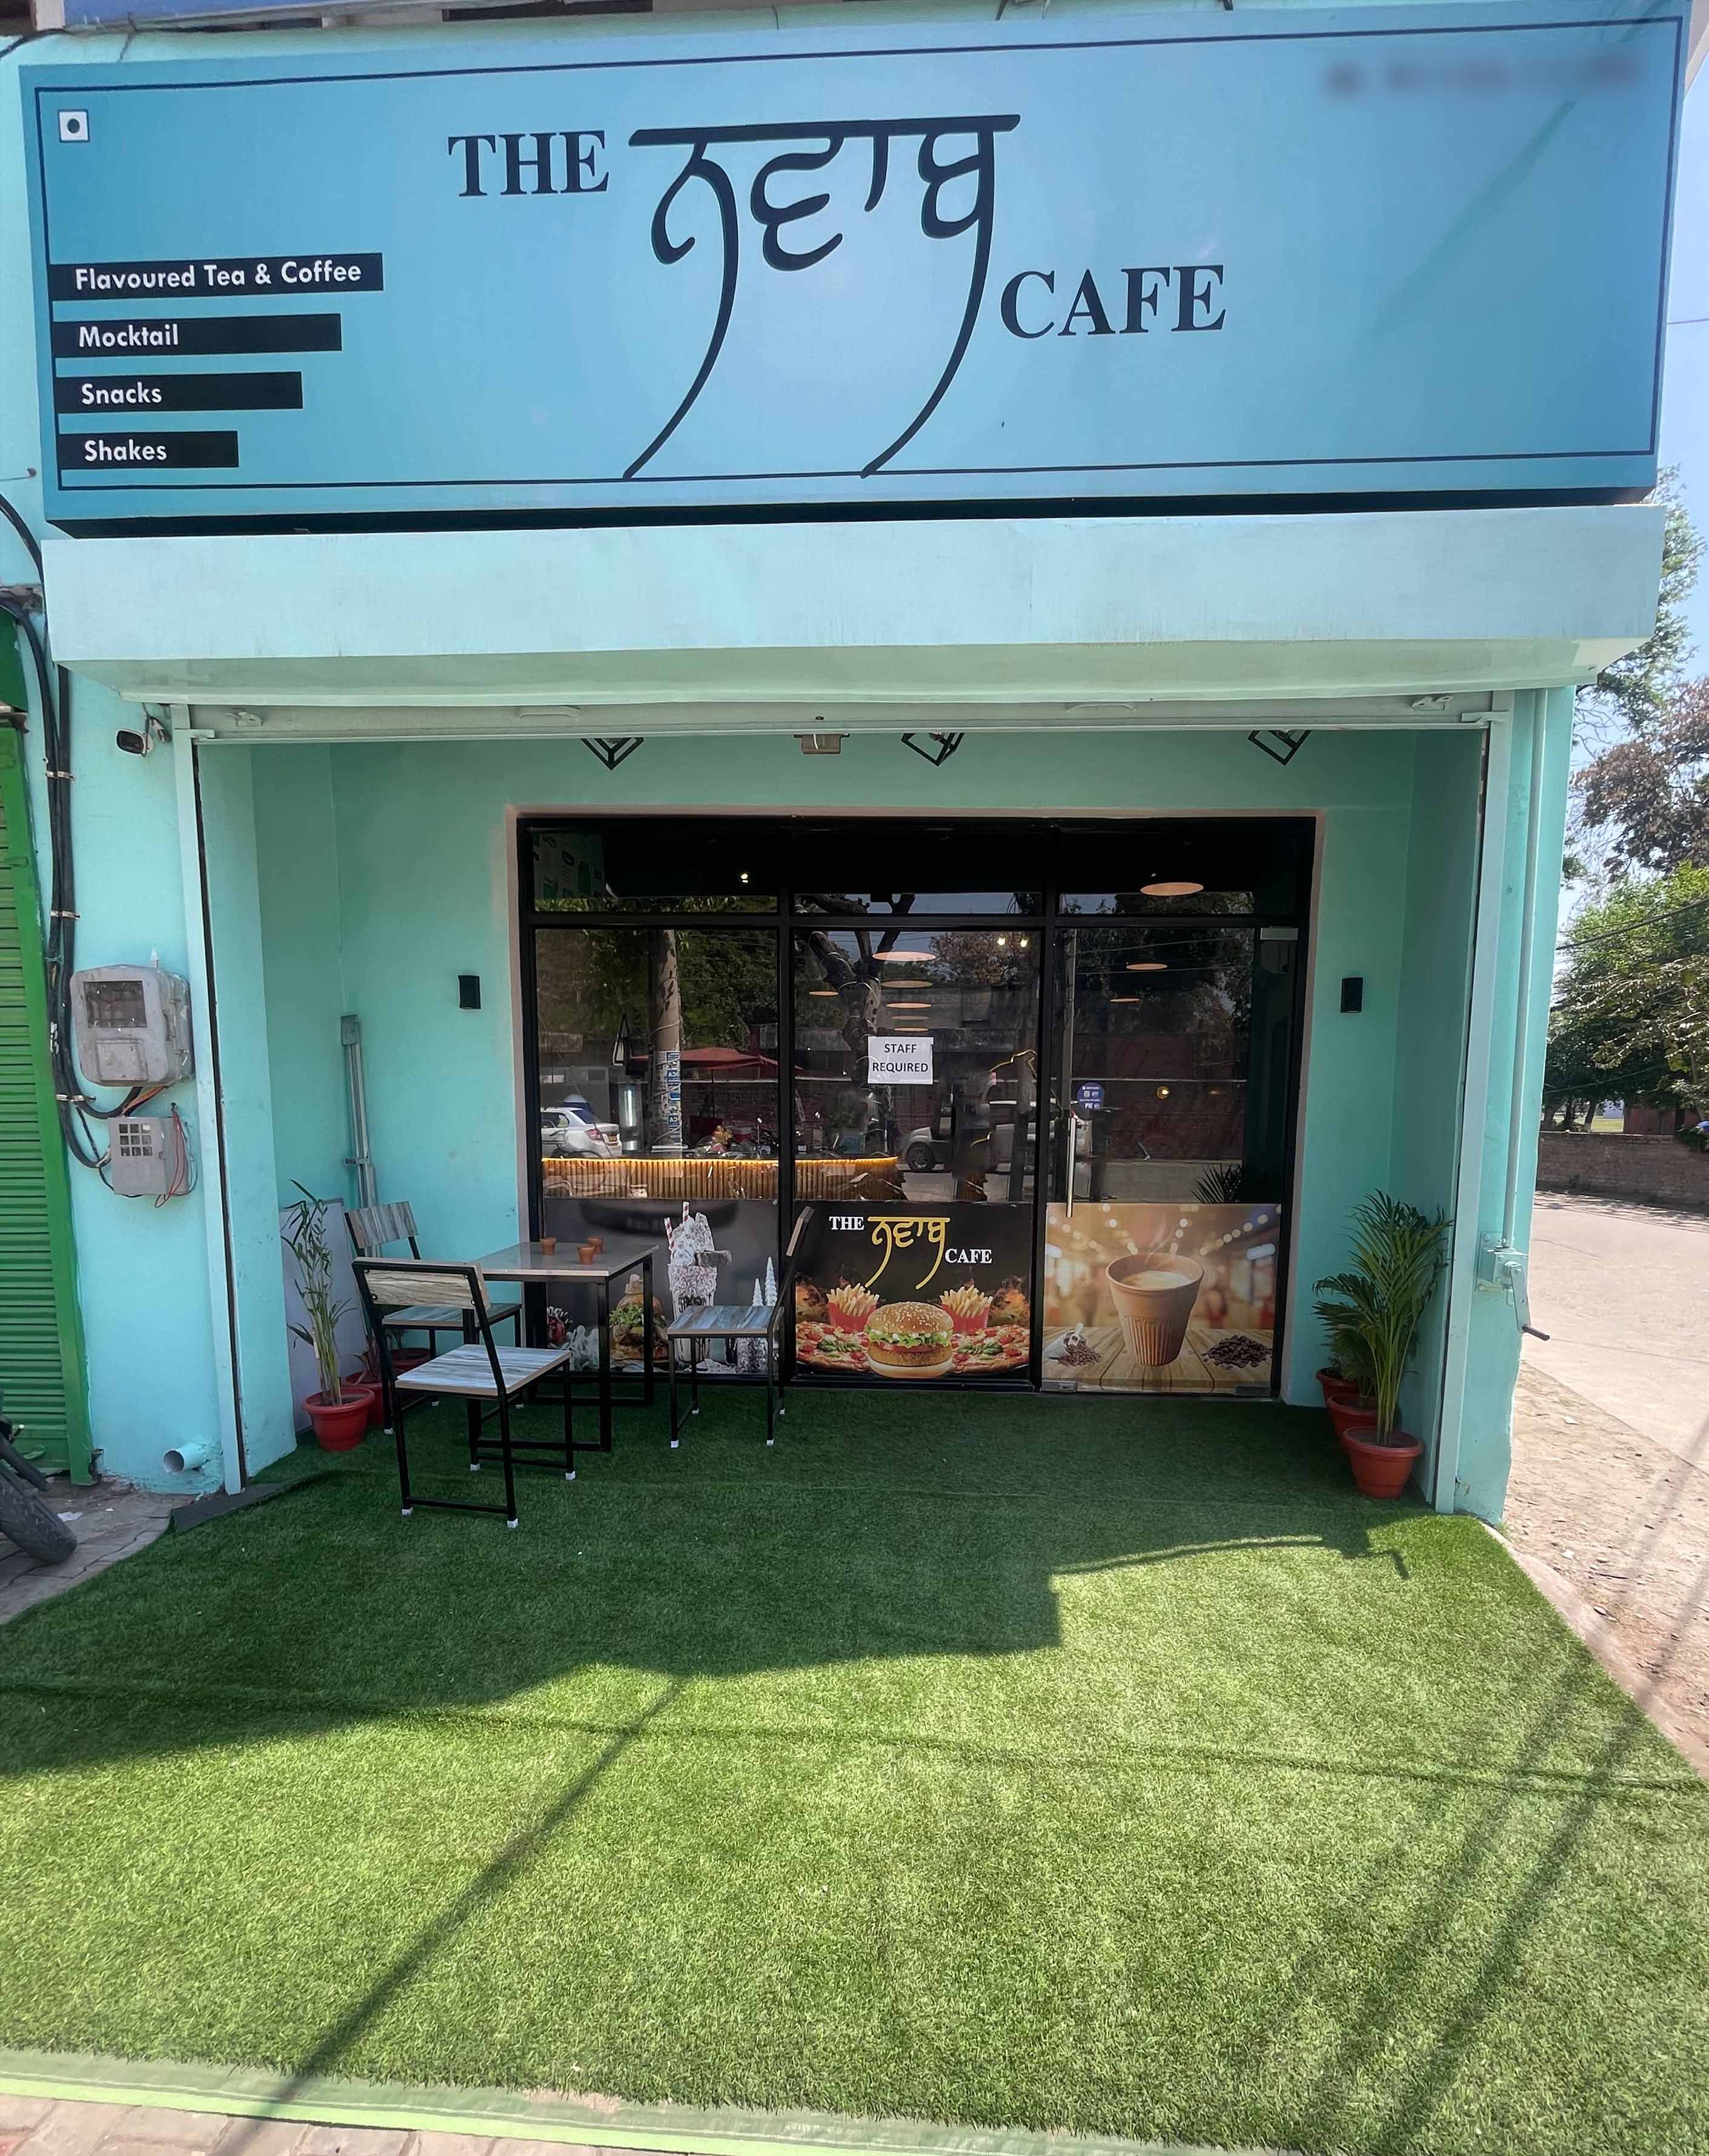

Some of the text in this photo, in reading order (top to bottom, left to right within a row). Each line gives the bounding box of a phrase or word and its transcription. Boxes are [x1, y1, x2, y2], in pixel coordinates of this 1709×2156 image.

[448, 130, 609, 197] THE
[1000, 264, 1226, 339] CAFE
[75, 259, 362, 290] Flavoured Tea & Coffee
[78, 323, 179, 348] Mocktail
[81, 382, 162, 405] Snacks
[84, 439, 167, 462] Shakes
[884, 1043, 917, 1053] STAFF
[872, 1062, 928, 1073] REQUIRED
[829, 1216, 864, 1230] THE
[944, 1248, 992, 1264] CAFE
